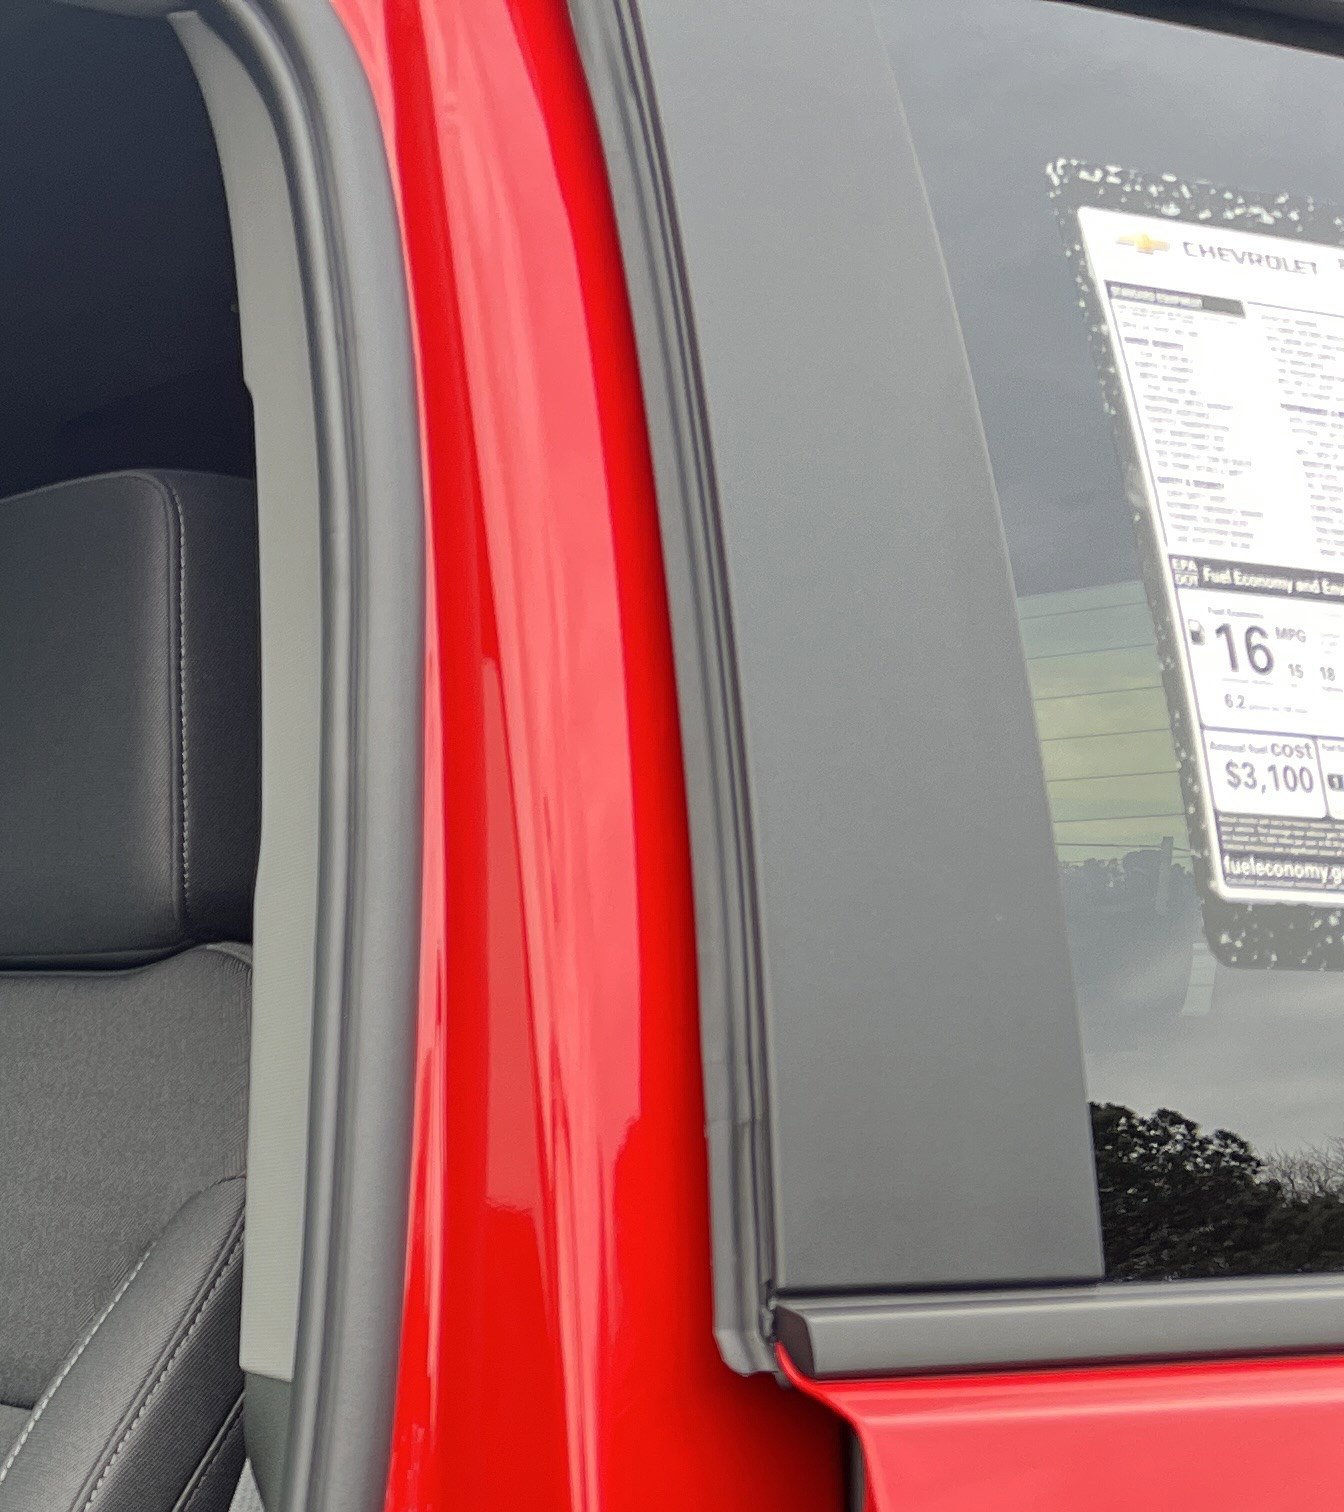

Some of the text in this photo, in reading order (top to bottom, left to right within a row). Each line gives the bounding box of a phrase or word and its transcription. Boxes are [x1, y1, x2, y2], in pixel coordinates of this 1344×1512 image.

[1182, 241, 1317, 274] CHEVROLET
[1202, 565, 1231, 584] Fuel
[1232, 568, 1294, 594] Economy
[1295, 578, 1320, 594] and
[1215, 622, 1307, 676] 16 MPG
[1287, 663, 1304, 679] 15
[1224, 758, 1315, 794] $3,100
[1223, 853, 1344, 886] fueleconomy.g
